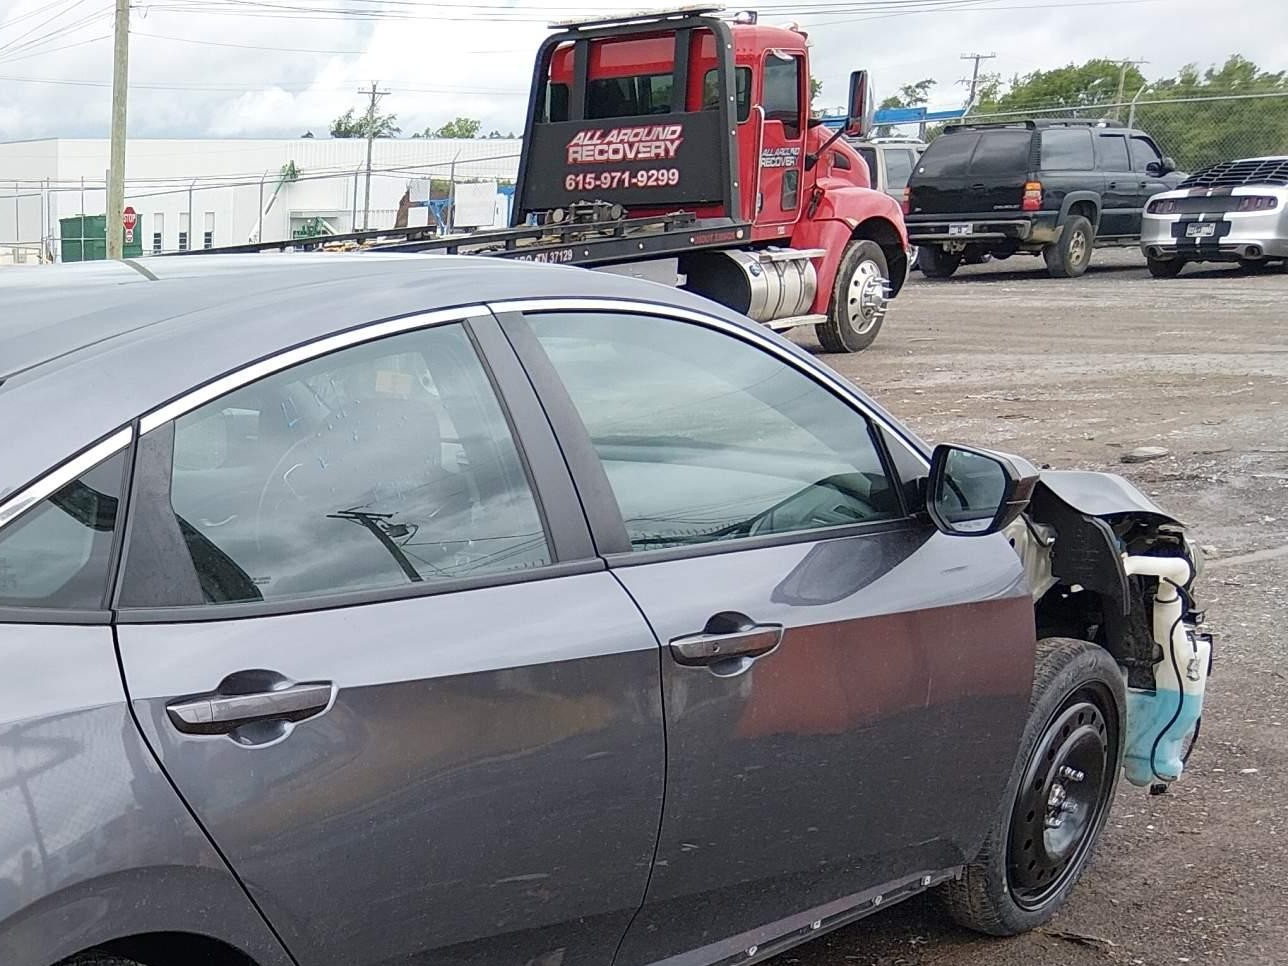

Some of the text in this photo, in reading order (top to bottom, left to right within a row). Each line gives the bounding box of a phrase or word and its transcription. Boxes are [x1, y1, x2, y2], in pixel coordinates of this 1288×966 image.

[569, 125, 683, 146] ALL AROUND
[568, 140, 681, 162] RECOVERY
[565, 168, 680, 191] 615-971-9299
[549, 249, 573, 264] 37129
